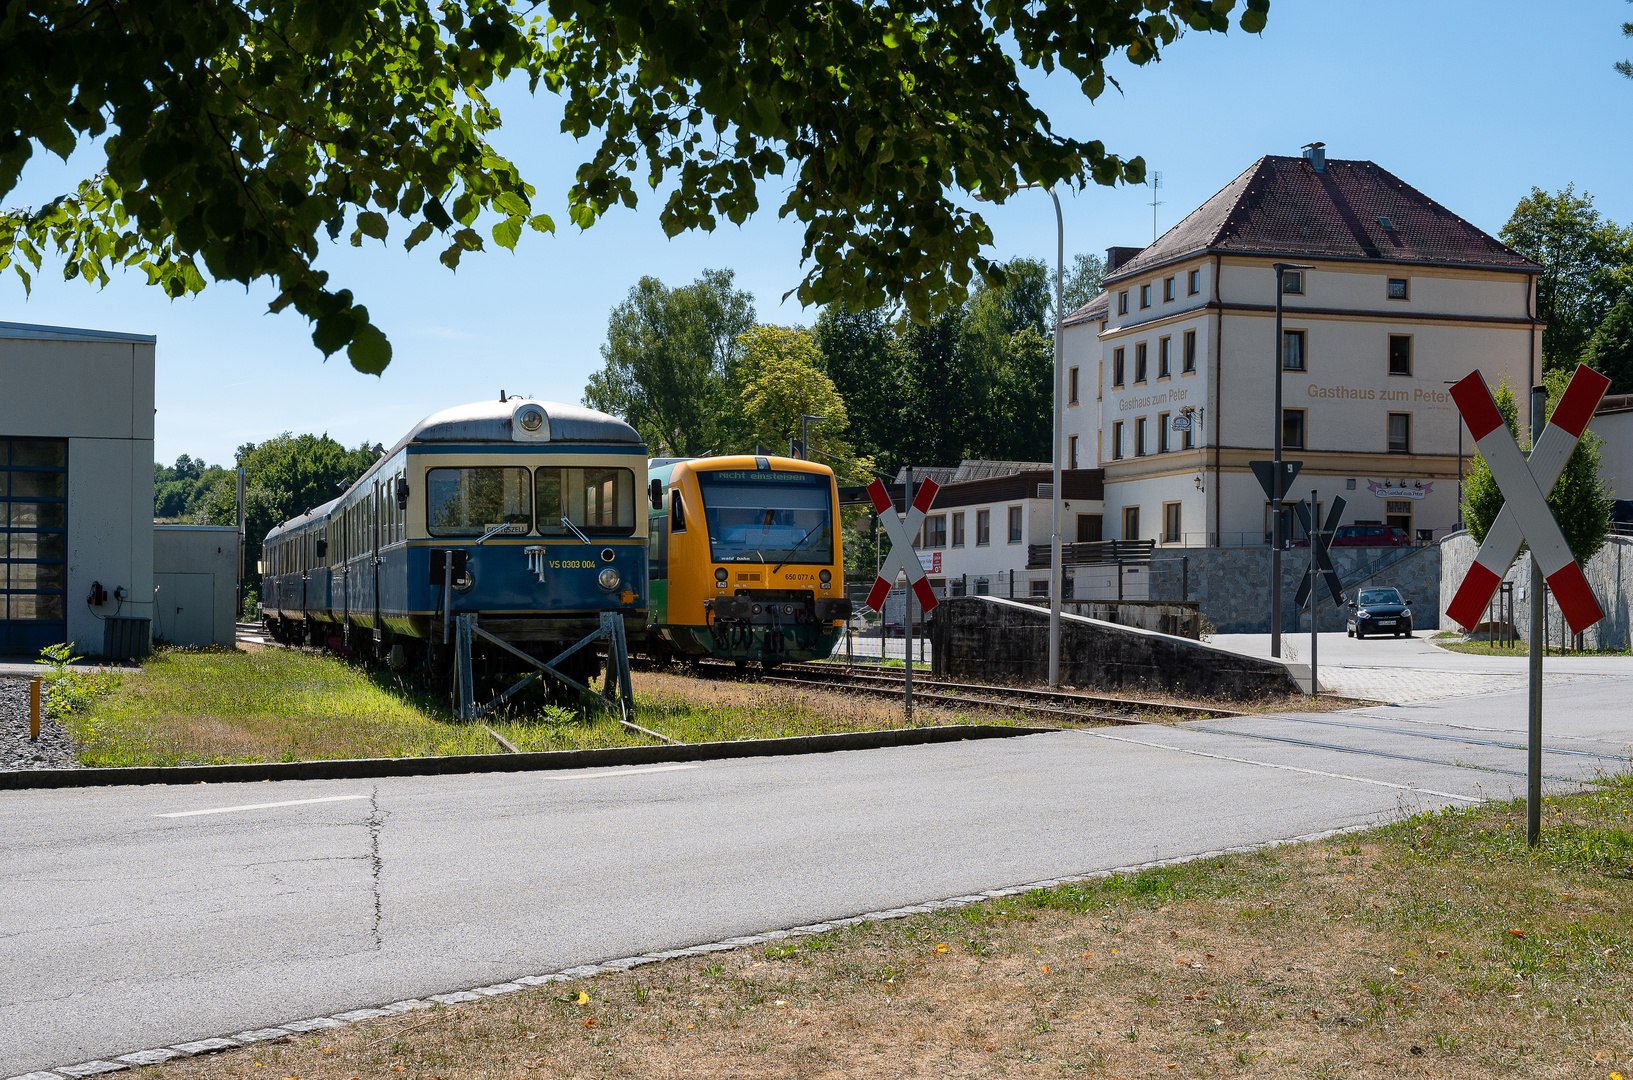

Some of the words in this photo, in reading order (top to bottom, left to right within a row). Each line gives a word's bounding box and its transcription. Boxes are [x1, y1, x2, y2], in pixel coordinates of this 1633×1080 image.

[1119, 396, 1150, 411] Gasthaus
[1152, 393, 1167, 405] zum
[1169, 388, 1188, 402] Peter
[1307, 384, 1376, 400] Gasthaus
[1378, 390, 1409, 401] zum
[1413, 388, 1451, 403] Peter
[750, 472, 806, 481] einsteigen
[549, 560, 560, 569] VS
[561, 560, 580, 569] 0303
[581, 560, 596, 569] 004
